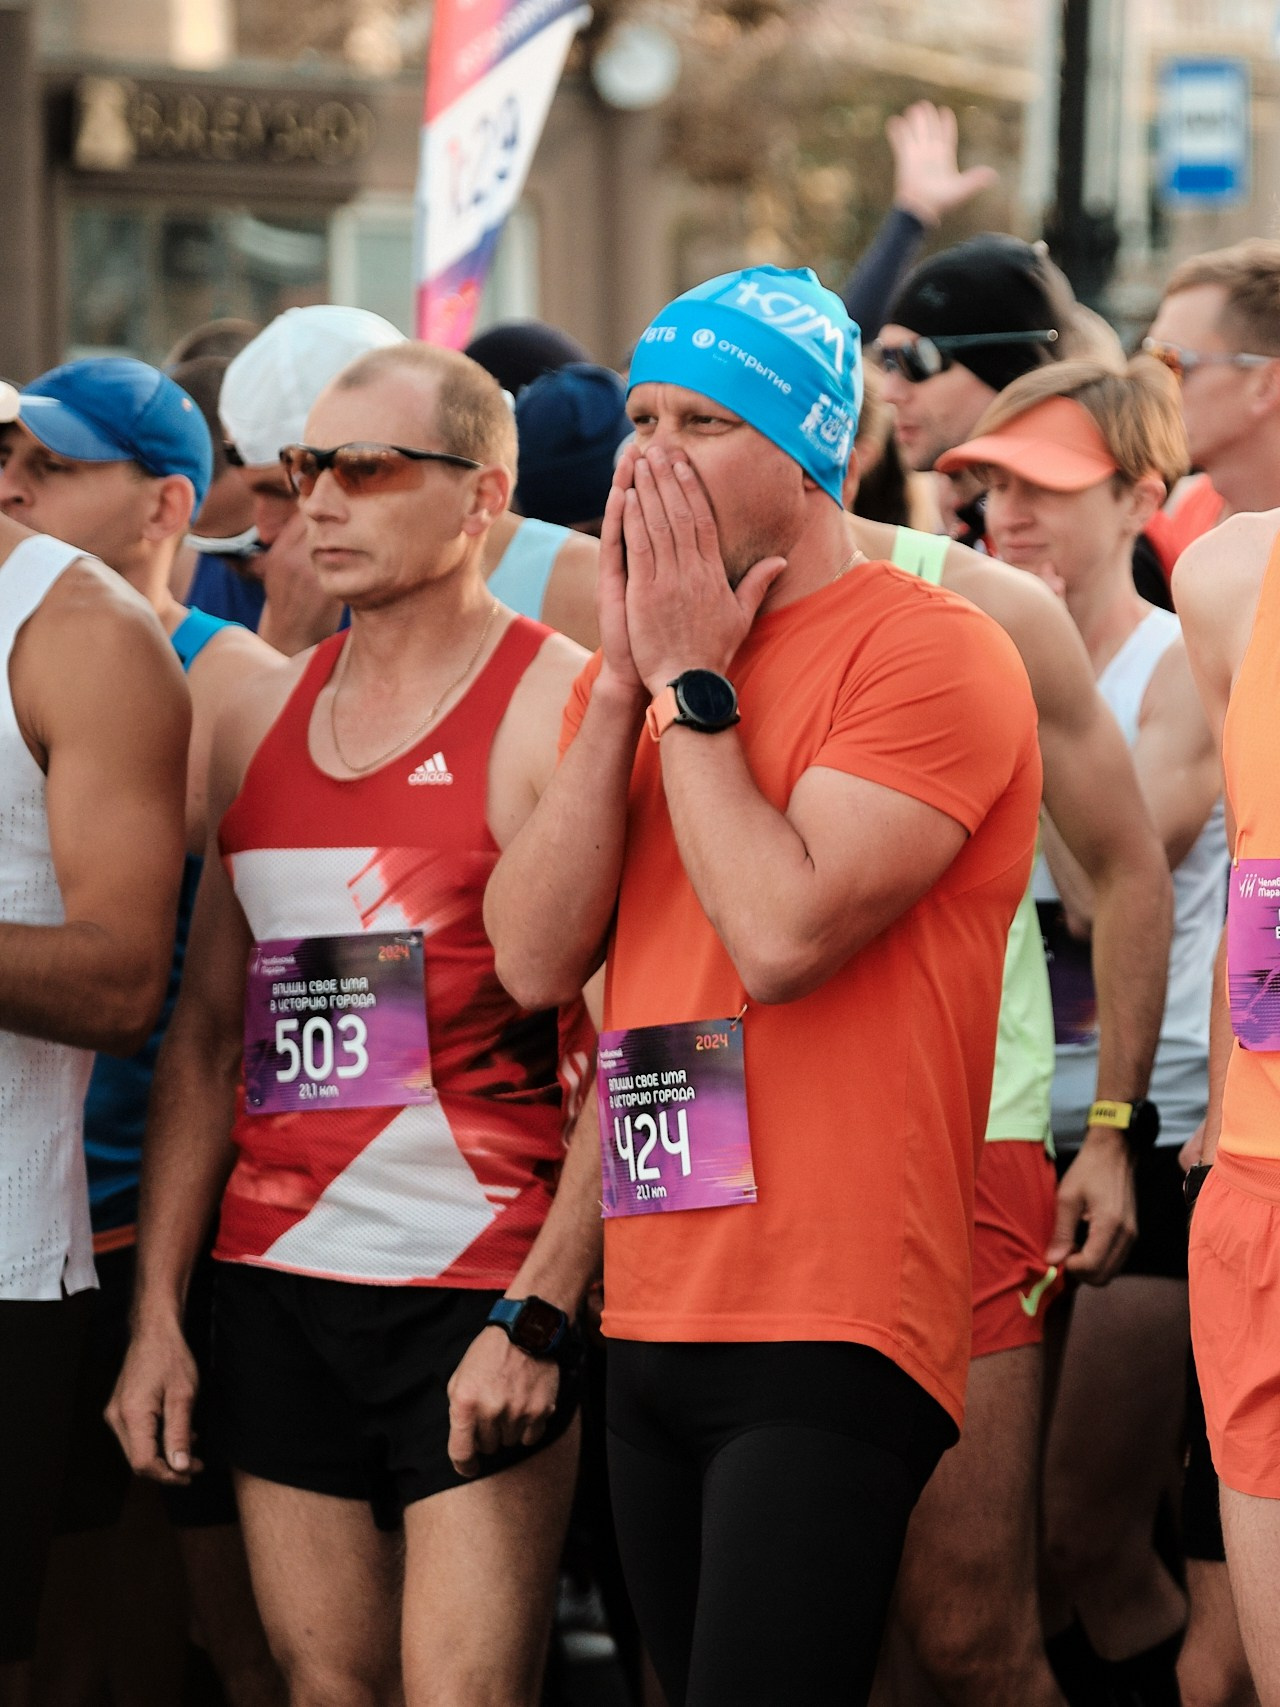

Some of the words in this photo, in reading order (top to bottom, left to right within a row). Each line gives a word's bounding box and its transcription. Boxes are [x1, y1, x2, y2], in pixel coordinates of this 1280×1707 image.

[645, 326, 677, 343] ВТБ
[408, 772, 454, 786] adidas
[378, 945, 409, 961] 2024
[309, 979, 338, 994] СВОЕ
[340, 977, 368, 992] ИМЯ
[330, 993, 376, 1009] ГОРОДА
[275, 1014, 369, 1083] 503
[696, 1034, 728, 1050] 2024
[635, 1073, 658, 1089] СВОЕ
[661, 1070, 686, 1085] ИМЯ
[615, 1090, 651, 1108] ИСТОРИЮ
[653, 1086, 695, 1104] ГОРОДА
[614, 1108, 691, 1182] 424
